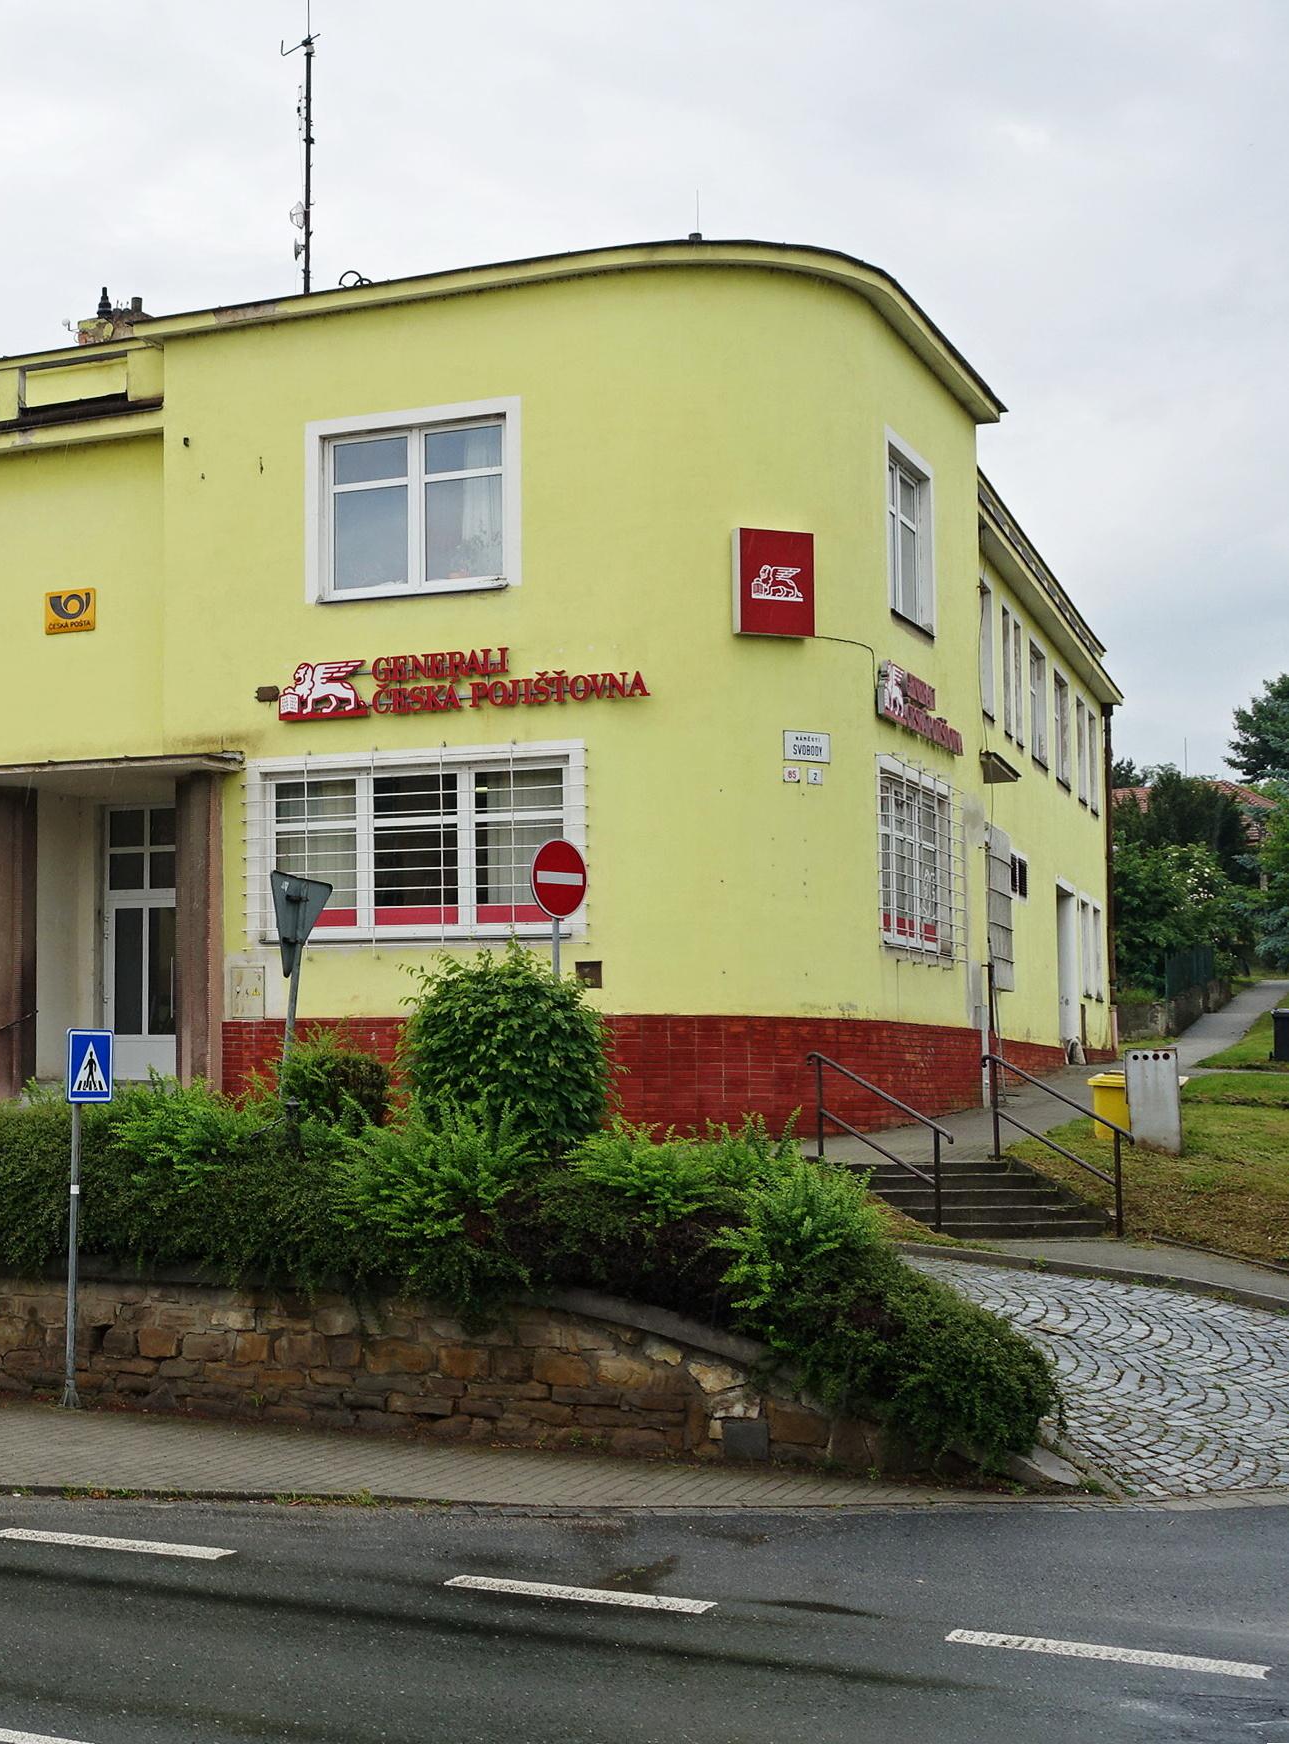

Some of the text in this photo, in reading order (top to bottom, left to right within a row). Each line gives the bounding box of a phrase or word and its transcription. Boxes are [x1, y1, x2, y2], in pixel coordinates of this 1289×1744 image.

[371, 647, 509, 682] GENERALI
[371, 670, 651, 715] ČESKÁ POJIŠŤOVNA
[793, 744, 822, 757] SVOBODY
[813, 772, 818, 781] 2
